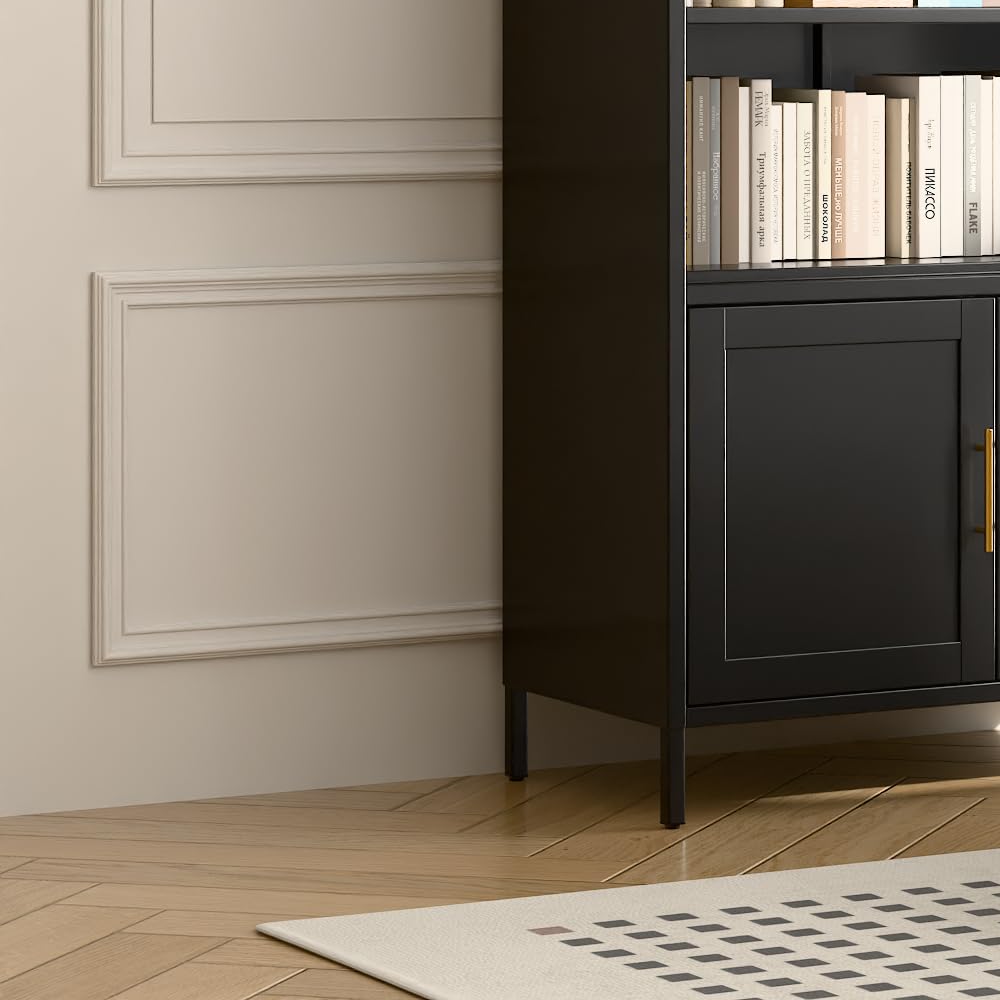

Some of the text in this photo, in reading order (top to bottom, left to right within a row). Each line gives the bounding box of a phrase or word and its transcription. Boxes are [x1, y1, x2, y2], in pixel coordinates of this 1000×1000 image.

[757, 152, 767, 248] Триумфальная арка
[803, 130, 811, 240] ЗАБОТА О ПРЕДАННЫХ
[924, 168, 935, 220] ПИКАССО
[821, 194, 829, 243] ШОКОЛАД
[834, 212, 843, 243] ЛУЧШЕ
[969, 202, 978, 234] FLAKE
